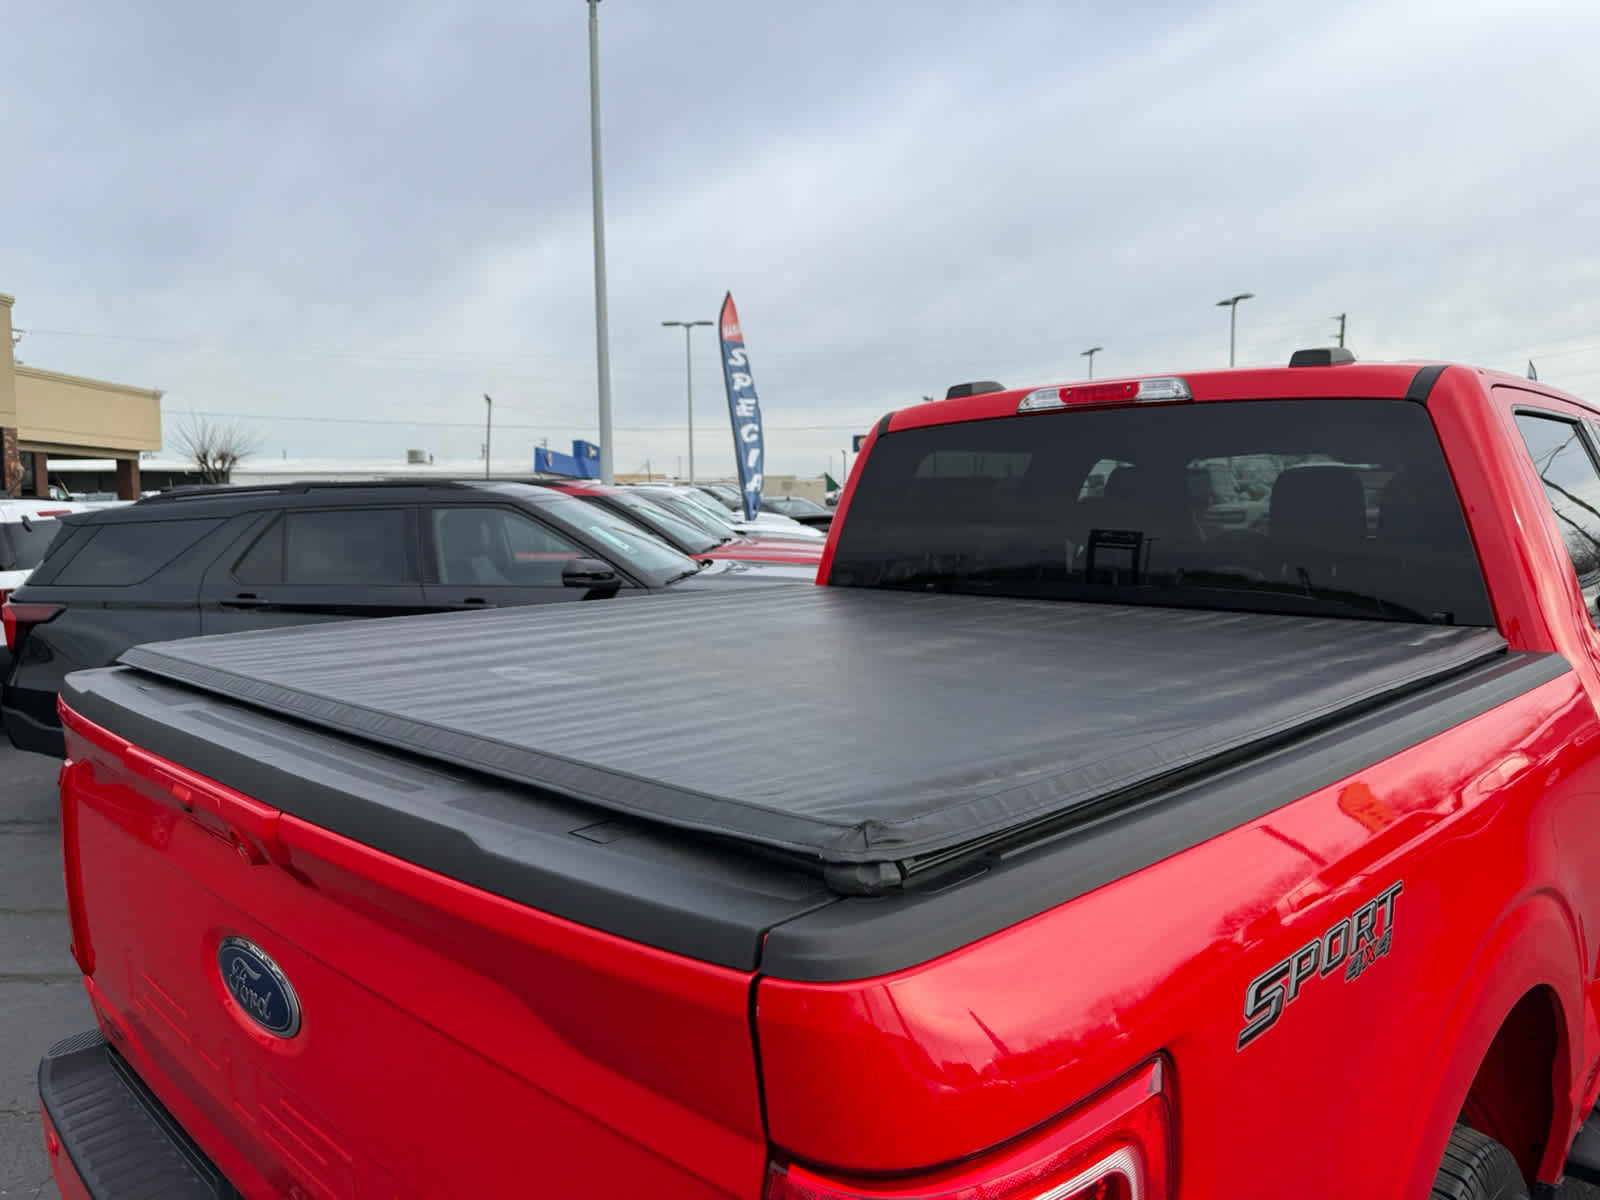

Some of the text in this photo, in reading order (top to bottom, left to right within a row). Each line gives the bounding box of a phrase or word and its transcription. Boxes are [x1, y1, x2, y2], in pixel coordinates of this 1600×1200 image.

[728, 348, 763, 494] SPECIA
[229, 956, 272, 1020] Ford
[1237, 880, 1403, 1052] SPORT
